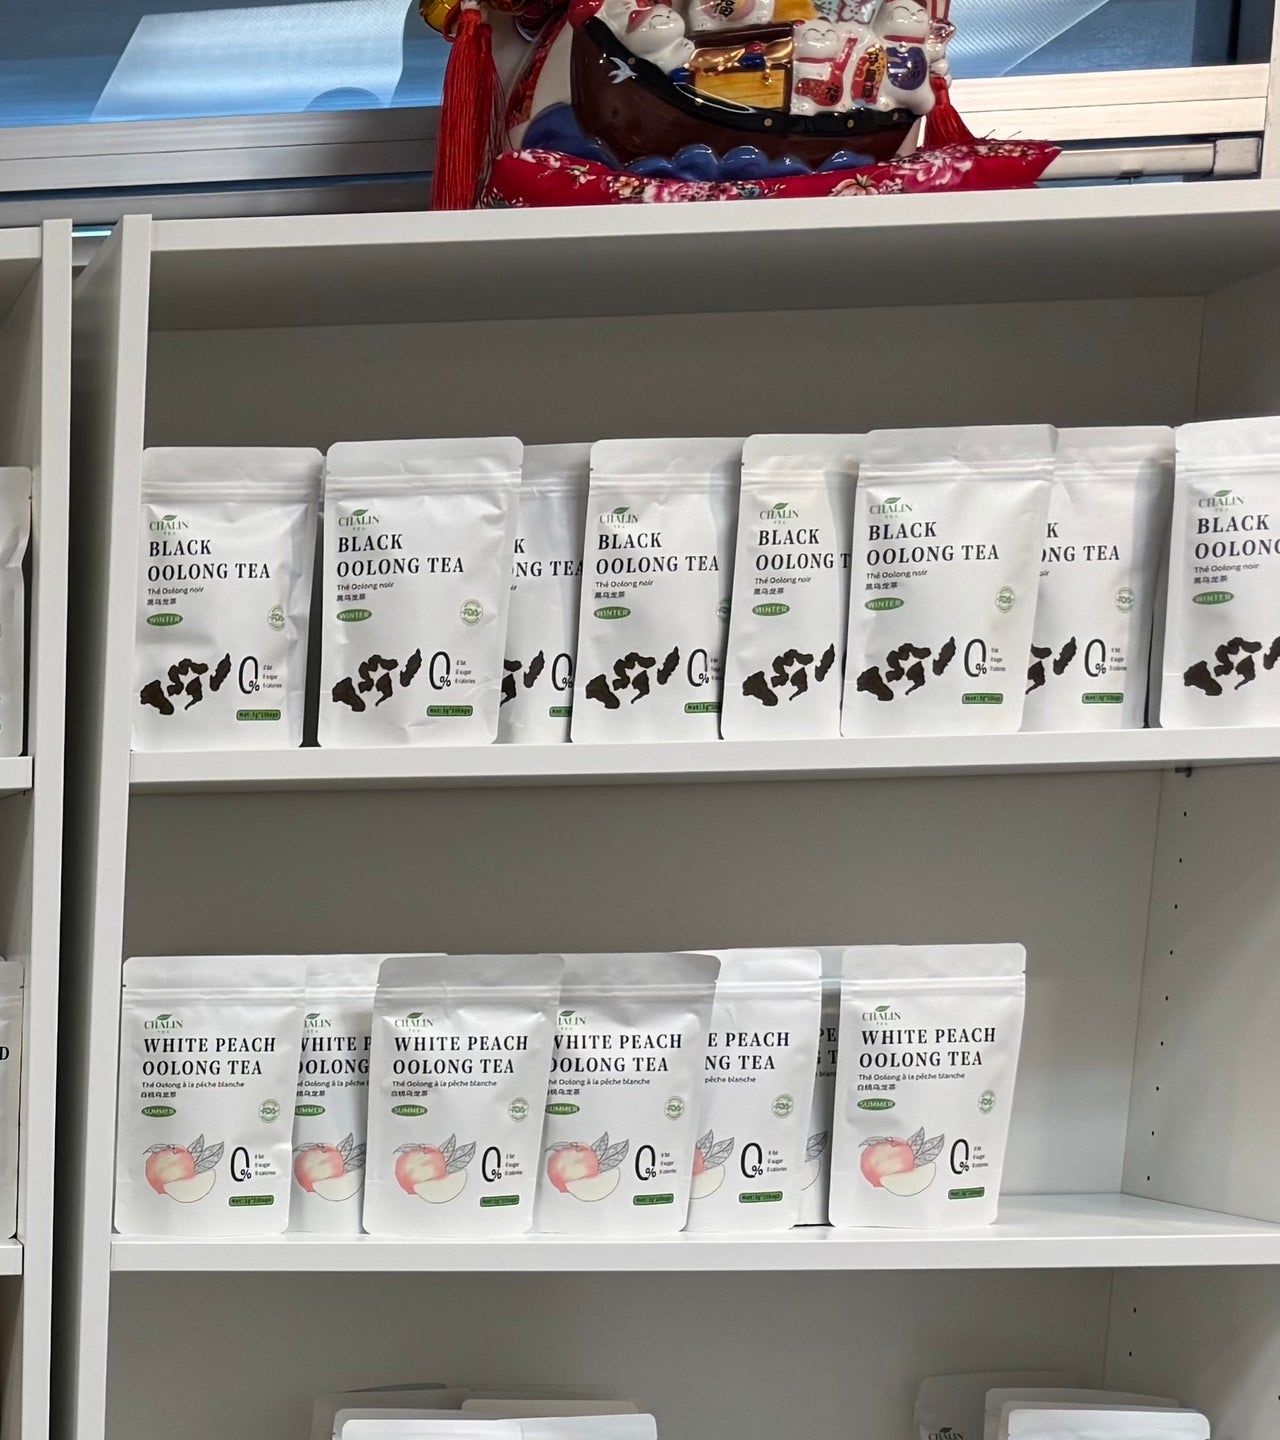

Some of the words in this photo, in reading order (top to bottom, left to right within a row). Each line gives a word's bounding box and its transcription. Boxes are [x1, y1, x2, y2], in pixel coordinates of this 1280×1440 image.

[868, 522, 936, 540] BLACK
[337, 533, 403, 554] BLACK
[867, 545, 954, 566] OOLONG
[961, 544, 999, 560] TEA
[336, 557, 420, 578] OOLONG
[427, 556, 464, 574] TEA
[882, 571, 910, 579] Oolong
[867, 600, 901, 608] WINTER
[862, 1012, 901, 1021] CHALIN
[862, 1029, 927, 1045] WHITE
[935, 1028, 995, 1043] PEACH
[860, 1052, 940, 1068] OOLONG
[948, 1051, 982, 1066] TEA
